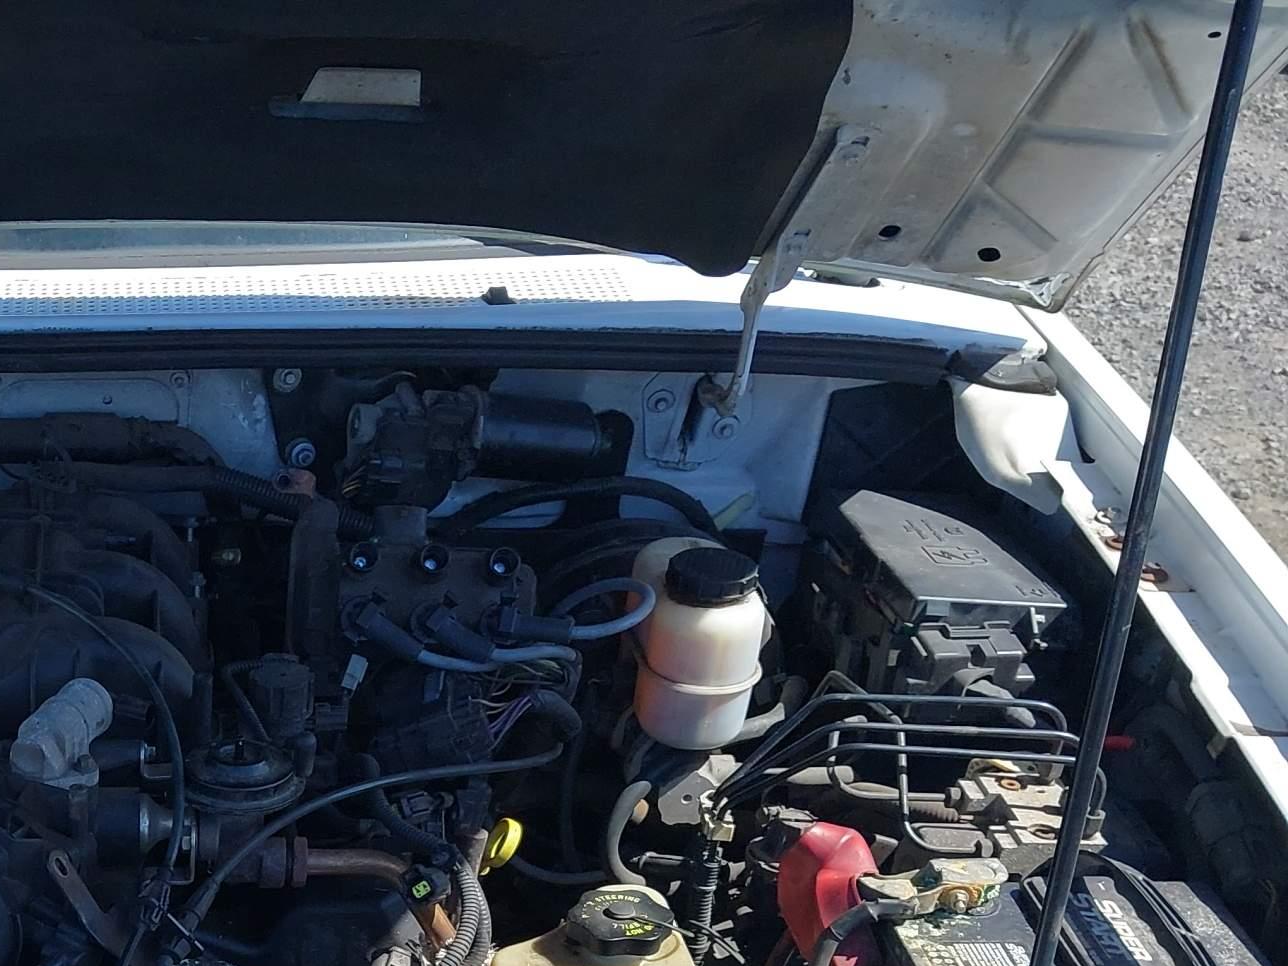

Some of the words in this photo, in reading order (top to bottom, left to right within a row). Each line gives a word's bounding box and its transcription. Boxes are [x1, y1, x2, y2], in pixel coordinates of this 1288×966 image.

[594, 893, 641, 904] STEERING
[624, 926, 645, 934] NOT
[1093, 898, 1153, 962] SUPER
